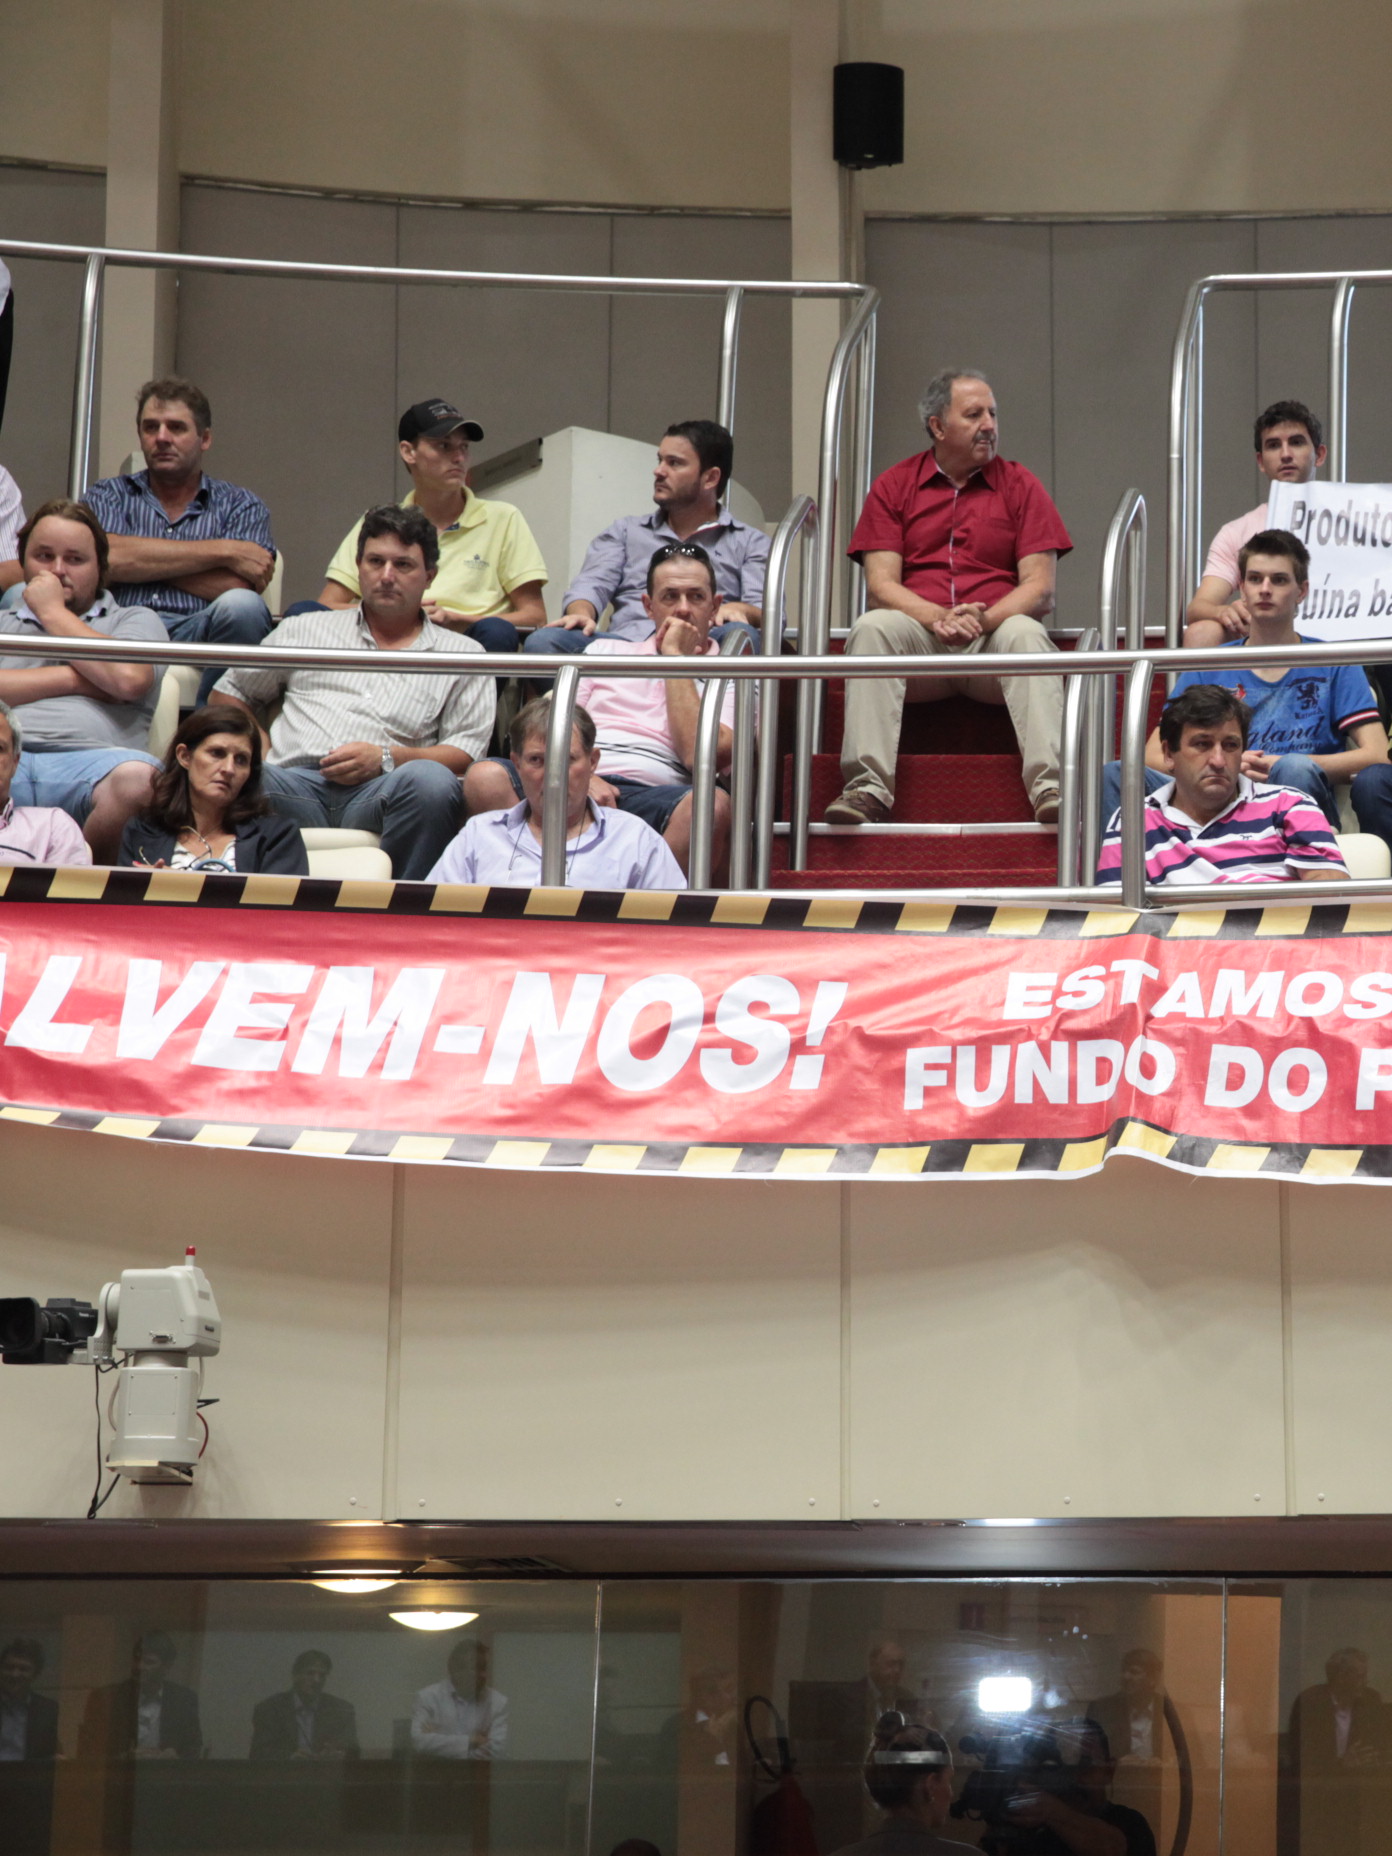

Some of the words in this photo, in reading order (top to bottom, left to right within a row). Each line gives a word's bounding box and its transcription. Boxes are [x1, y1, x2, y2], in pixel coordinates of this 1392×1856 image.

[1294, 573, 1361, 620] uína
[0, 952, 848, 1094] LVEM-NOS!
[903, 1035, 1176, 1111] FUNDO
[1204, 1047, 1328, 1113] DO
